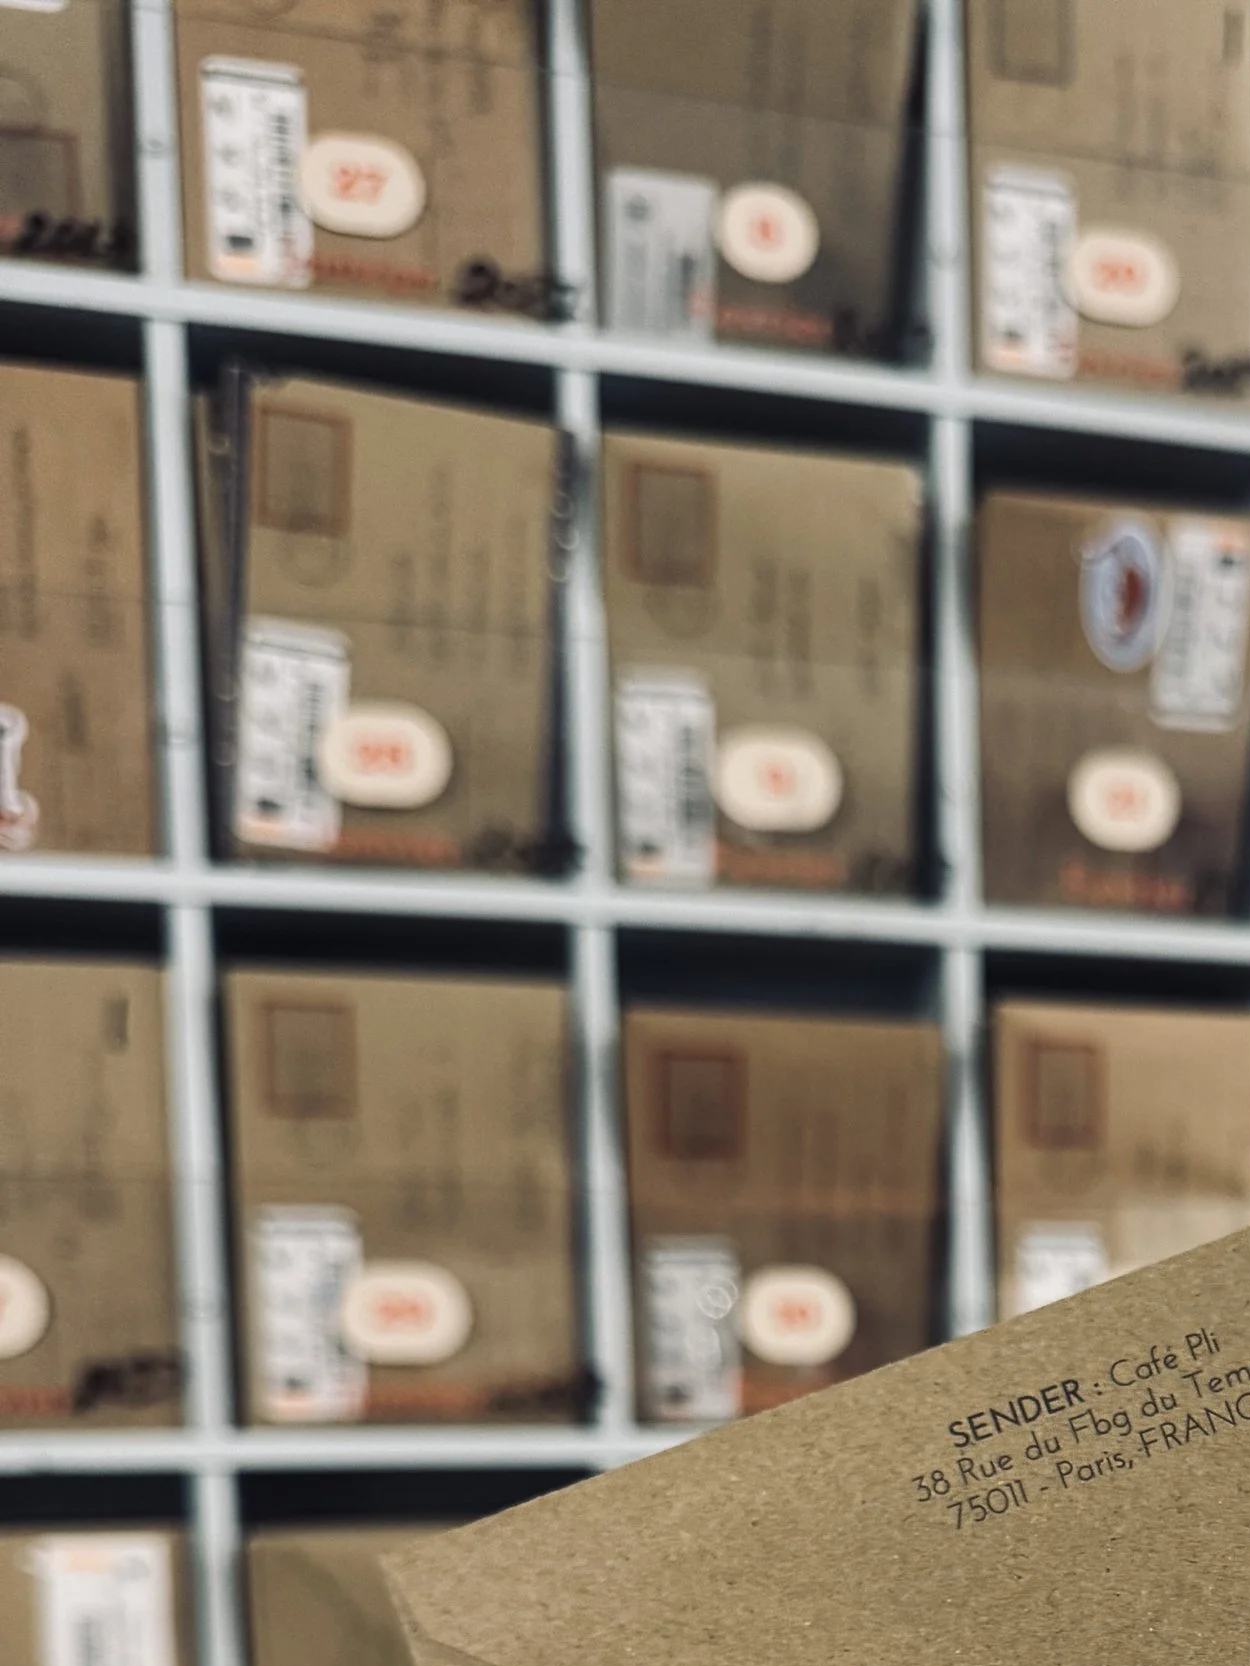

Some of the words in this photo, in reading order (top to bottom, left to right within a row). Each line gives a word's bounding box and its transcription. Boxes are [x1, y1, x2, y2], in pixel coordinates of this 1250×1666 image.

[948, 1378, 1085, 1448] SENDER
[1110, 1346, 1178, 1388] Café
[1184, 1327, 1221, 1360] Pli
[911, 1468, 952, 1503] 38
[957, 1456, 1014, 1486] Rue
[1024, 1430, 1063, 1461] du
[1067, 1408, 1133, 1446] Fbg
[1141, 1388, 1178, 1419] du
[946, 1479, 1028, 1530] 75011
[1056, 1449, 1135, 1490] Paris,
